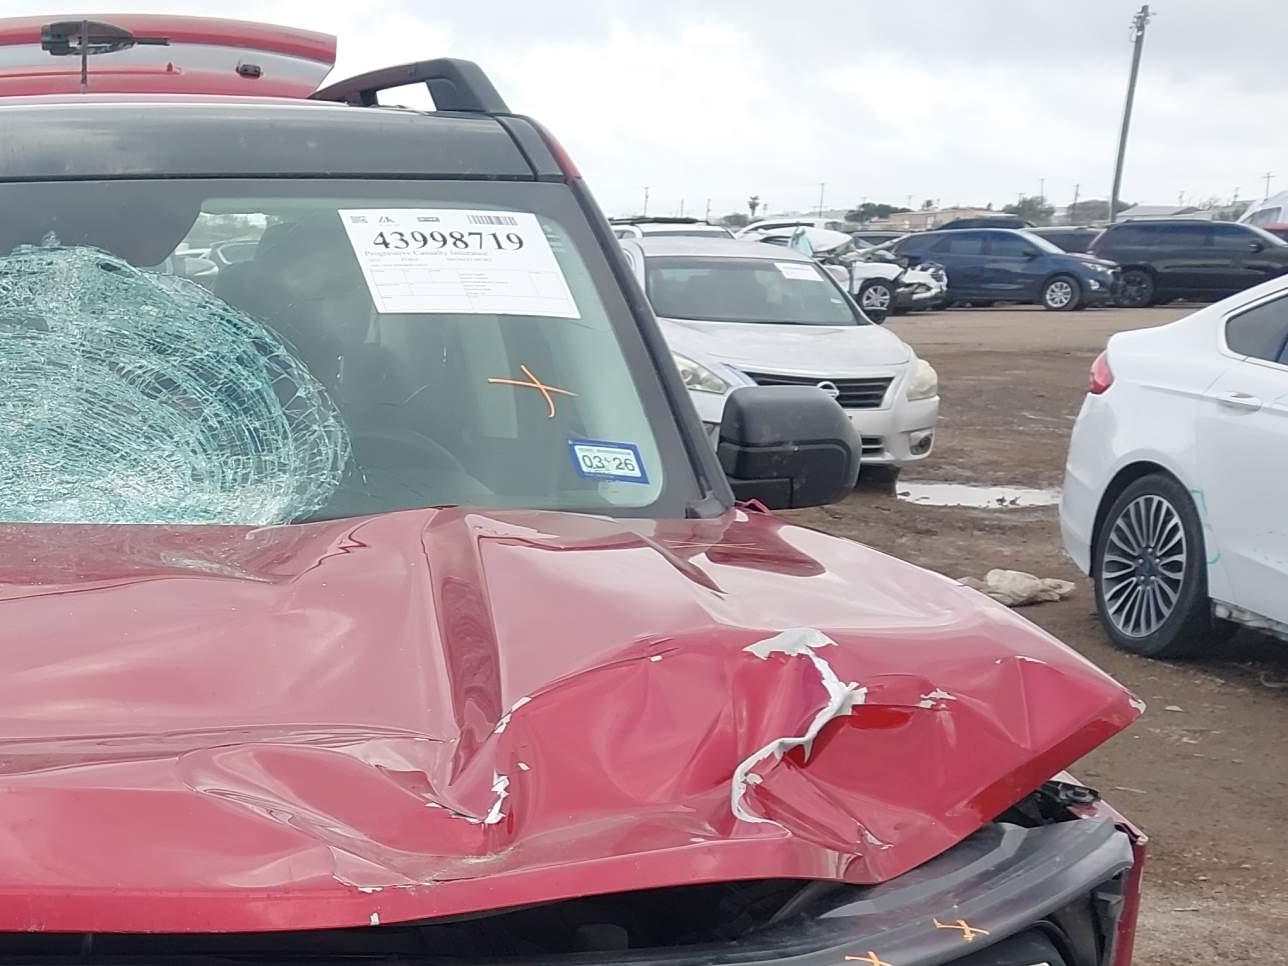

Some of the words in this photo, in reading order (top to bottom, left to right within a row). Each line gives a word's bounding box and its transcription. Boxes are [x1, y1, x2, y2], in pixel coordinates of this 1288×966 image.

[373, 231, 524, 251] 43998719
[582, 454, 605, 470] 03
[613, 456, 635, 472] 26
